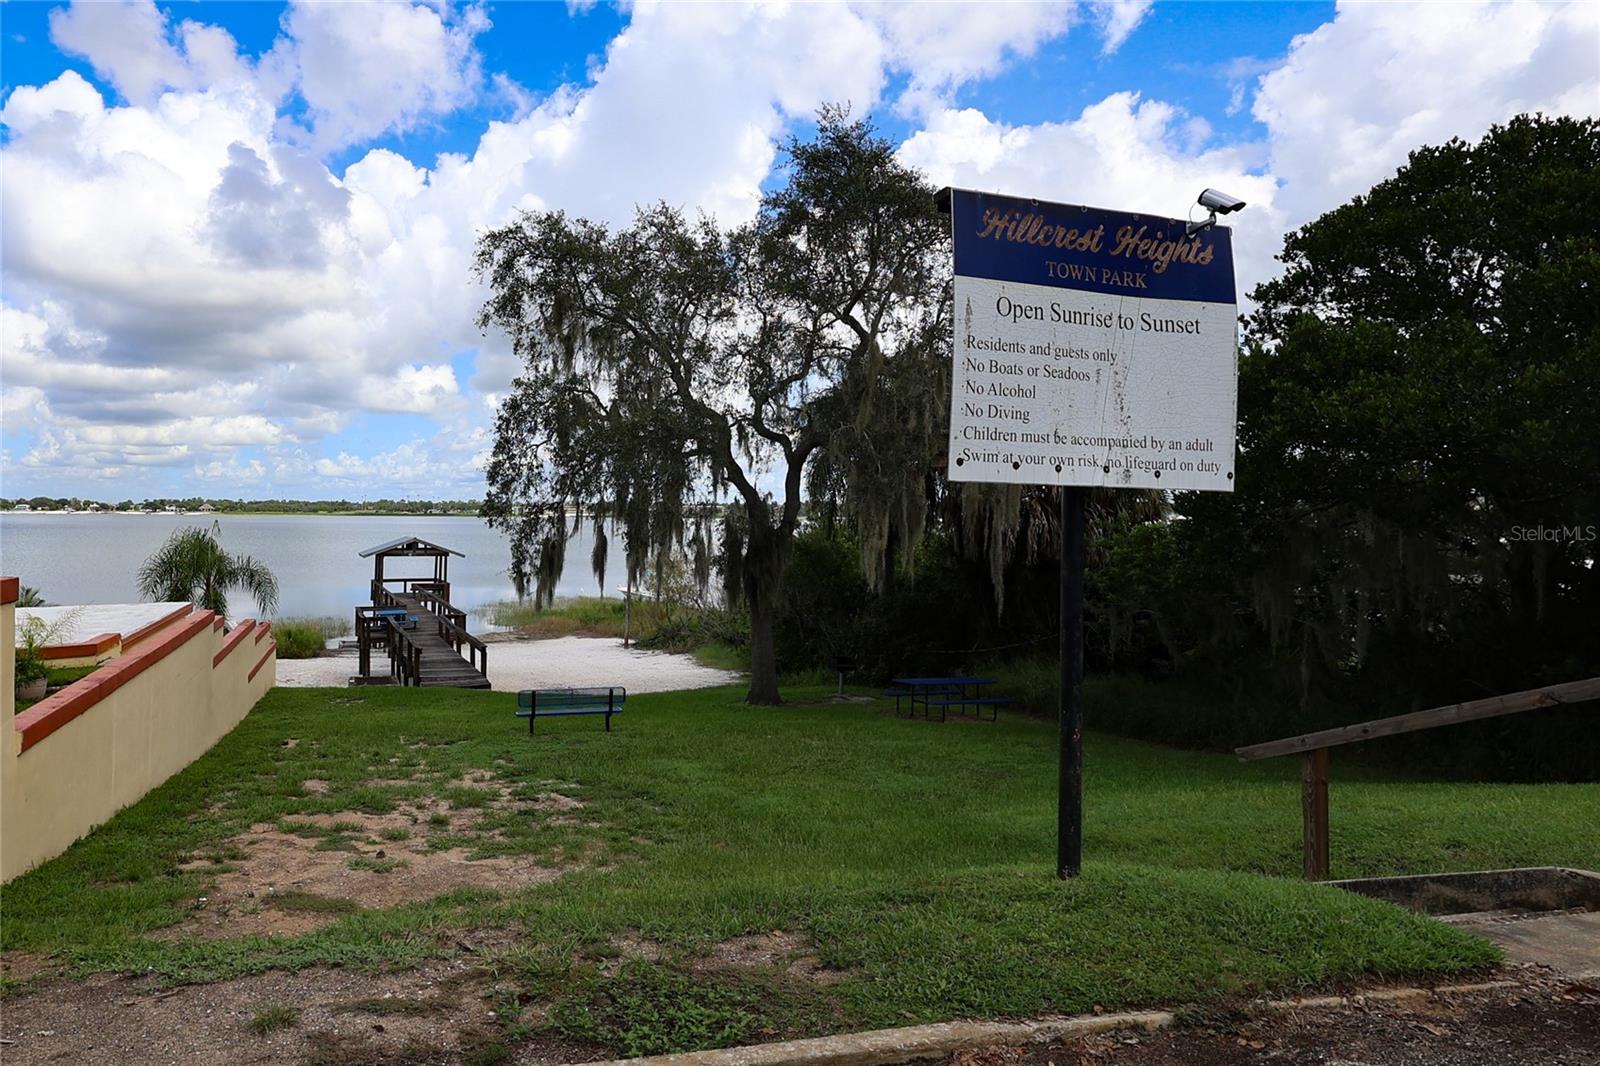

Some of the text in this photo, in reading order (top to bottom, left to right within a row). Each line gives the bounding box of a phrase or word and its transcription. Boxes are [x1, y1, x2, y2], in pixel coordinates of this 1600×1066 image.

[976, 207, 1214, 274] Hillcrest Heights
[1046, 261, 1148, 288] TOWN PARK
[996, 296, 1201, 334] Open Sunrise to Sunset
[966, 336, 1118, 365] Residents and guests only
[966, 358, 1090, 382] No Boats or Seadoos
[966, 381, 1036, 399] No Alcohol
[964, 403, 1030, 424] No Diving
[963, 426, 1213, 452] Children must be accompanied by an adult
[962, 448, 999, 463] Swim
[1002, 452, 1014, 464] at
[1018, 453, 1046, 468] your
[1049, 456, 1075, 466] own
[1106, 457, 1122, 468] no
[1125, 456, 1177, 475] lifeguard
[1180, 460, 1194, 472] on
[1197, 457, 1221, 474] duty
